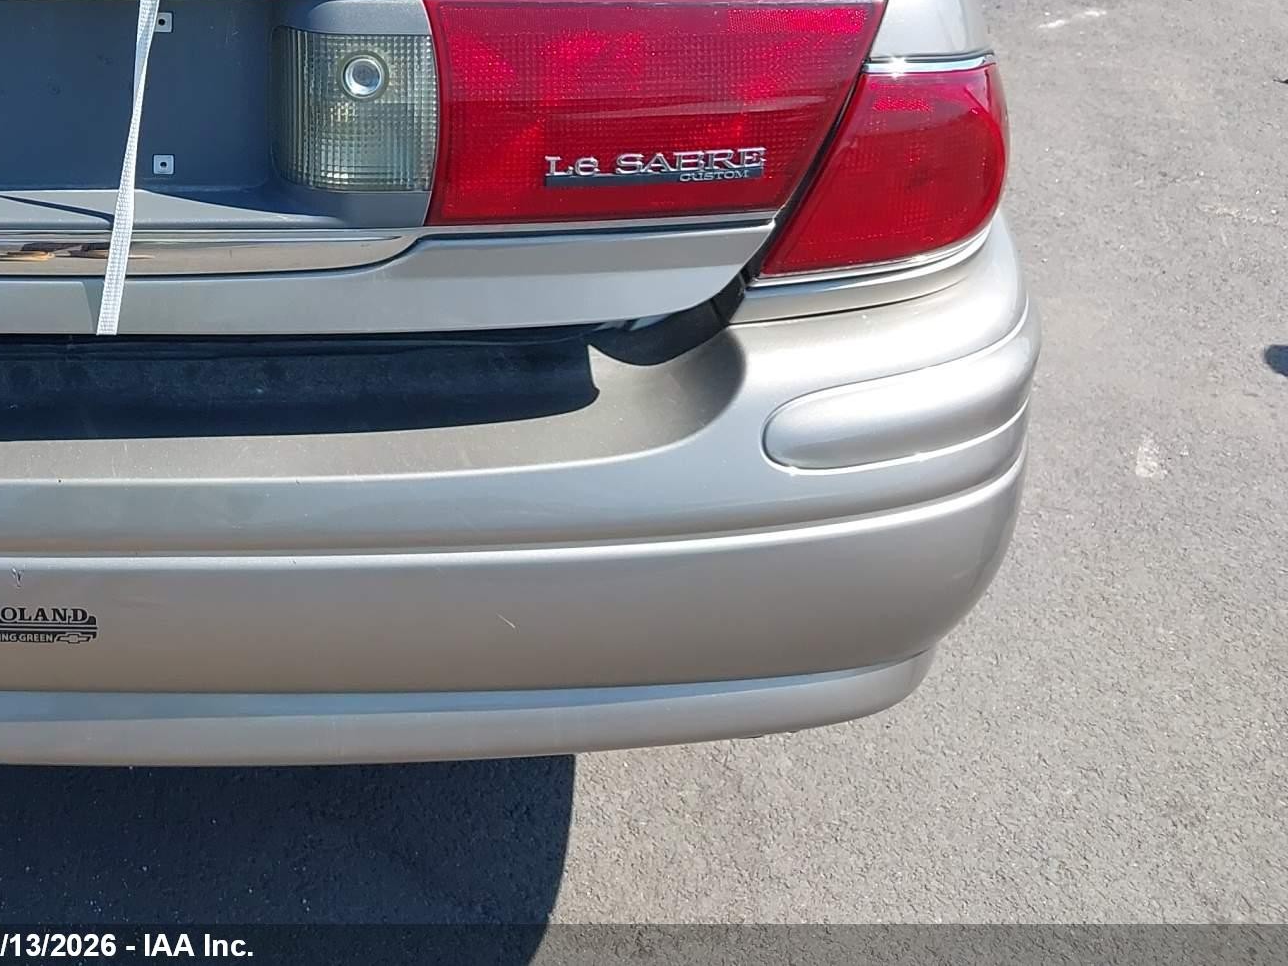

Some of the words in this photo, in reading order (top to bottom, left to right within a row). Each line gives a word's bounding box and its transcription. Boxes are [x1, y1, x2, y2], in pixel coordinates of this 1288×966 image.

[545, 155, 600, 177] Le
[615, 146, 767, 176] SABRE
[679, 169, 750, 182] CUSTOM
[18, 633, 54, 643] GREEN
